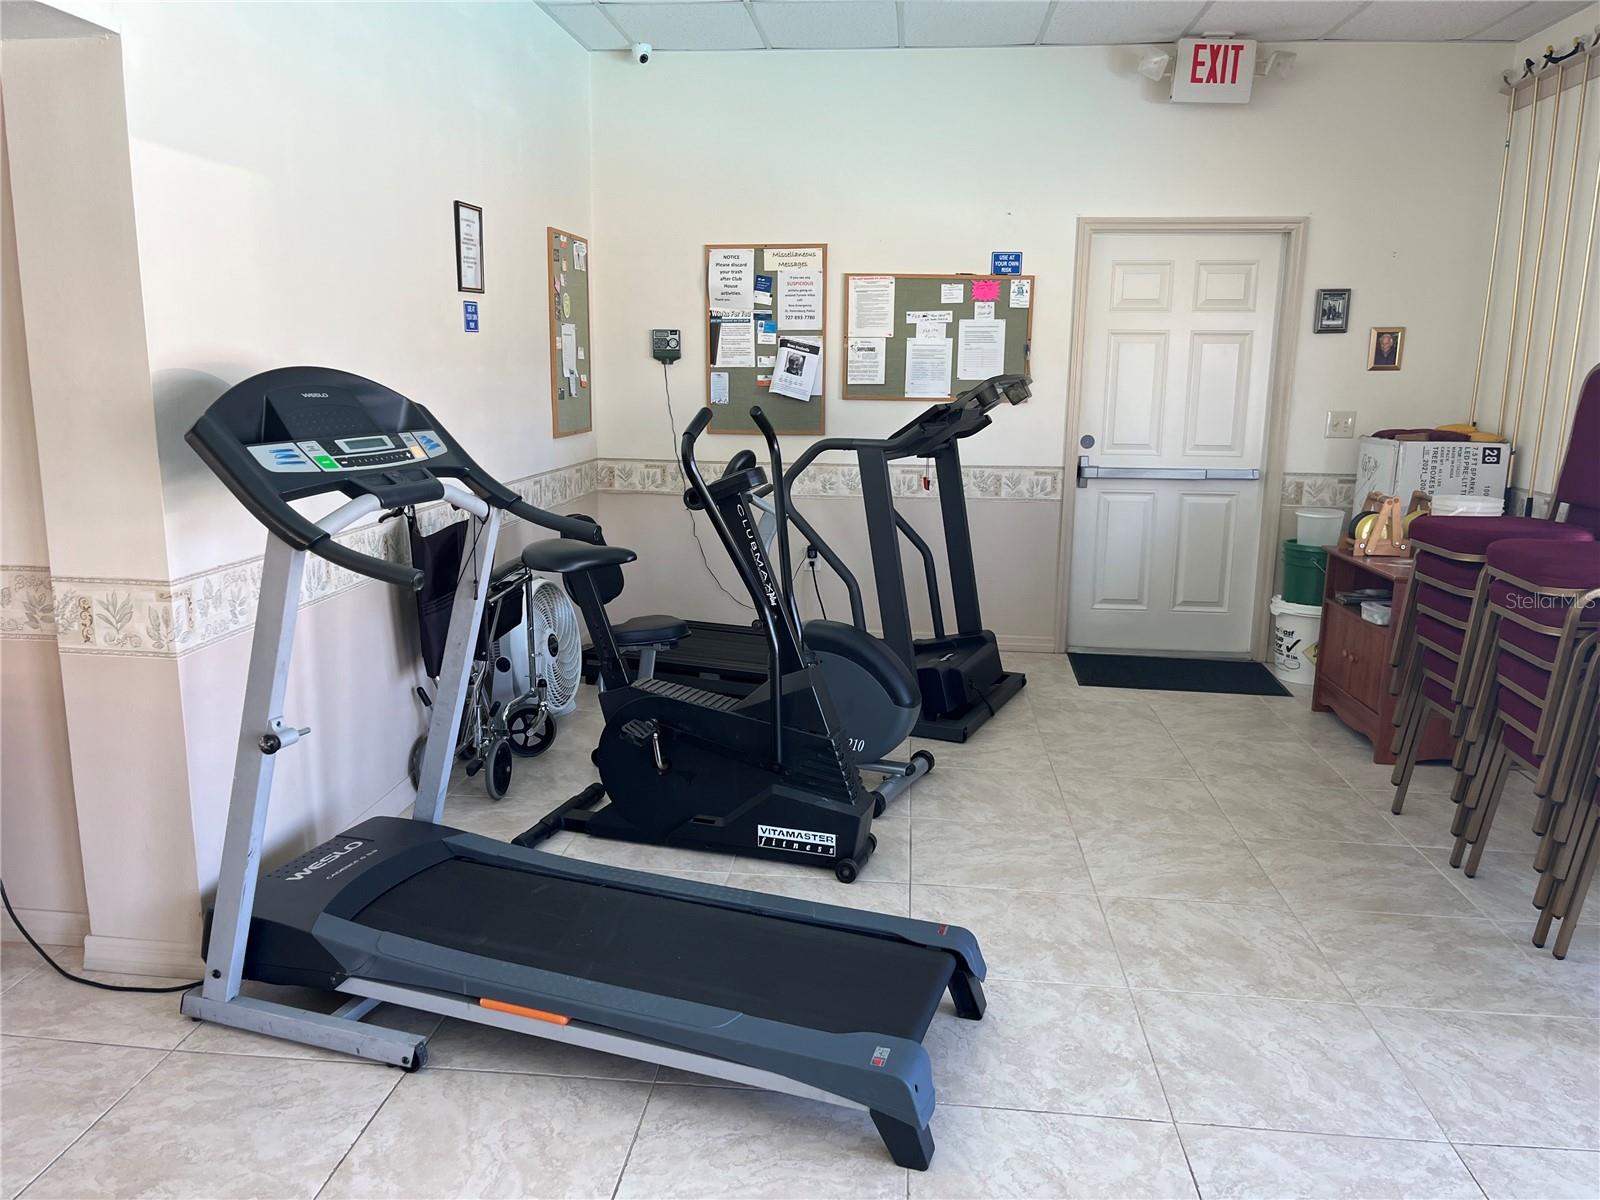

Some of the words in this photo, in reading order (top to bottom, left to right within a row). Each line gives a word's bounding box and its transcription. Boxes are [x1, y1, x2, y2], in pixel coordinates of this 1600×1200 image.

[1190, 44, 1244, 84] EXIT
[778, 261, 808, 269] Messages
[1431, 447, 1439, 464] TREE
[1463, 446, 1471, 461] LED
[1471, 457, 1478, 466] FT
[1485, 449, 1498, 463] 28
[1428, 466, 1437, 489] BOXES
[1461, 461, 1470, 488] PRE-LIT
[737, 504, 774, 593] CLUBMAX
[760, 827, 834, 844] VITAMASTER
[760, 836, 834, 855] fitness
[285, 841, 364, 880] WESLO
